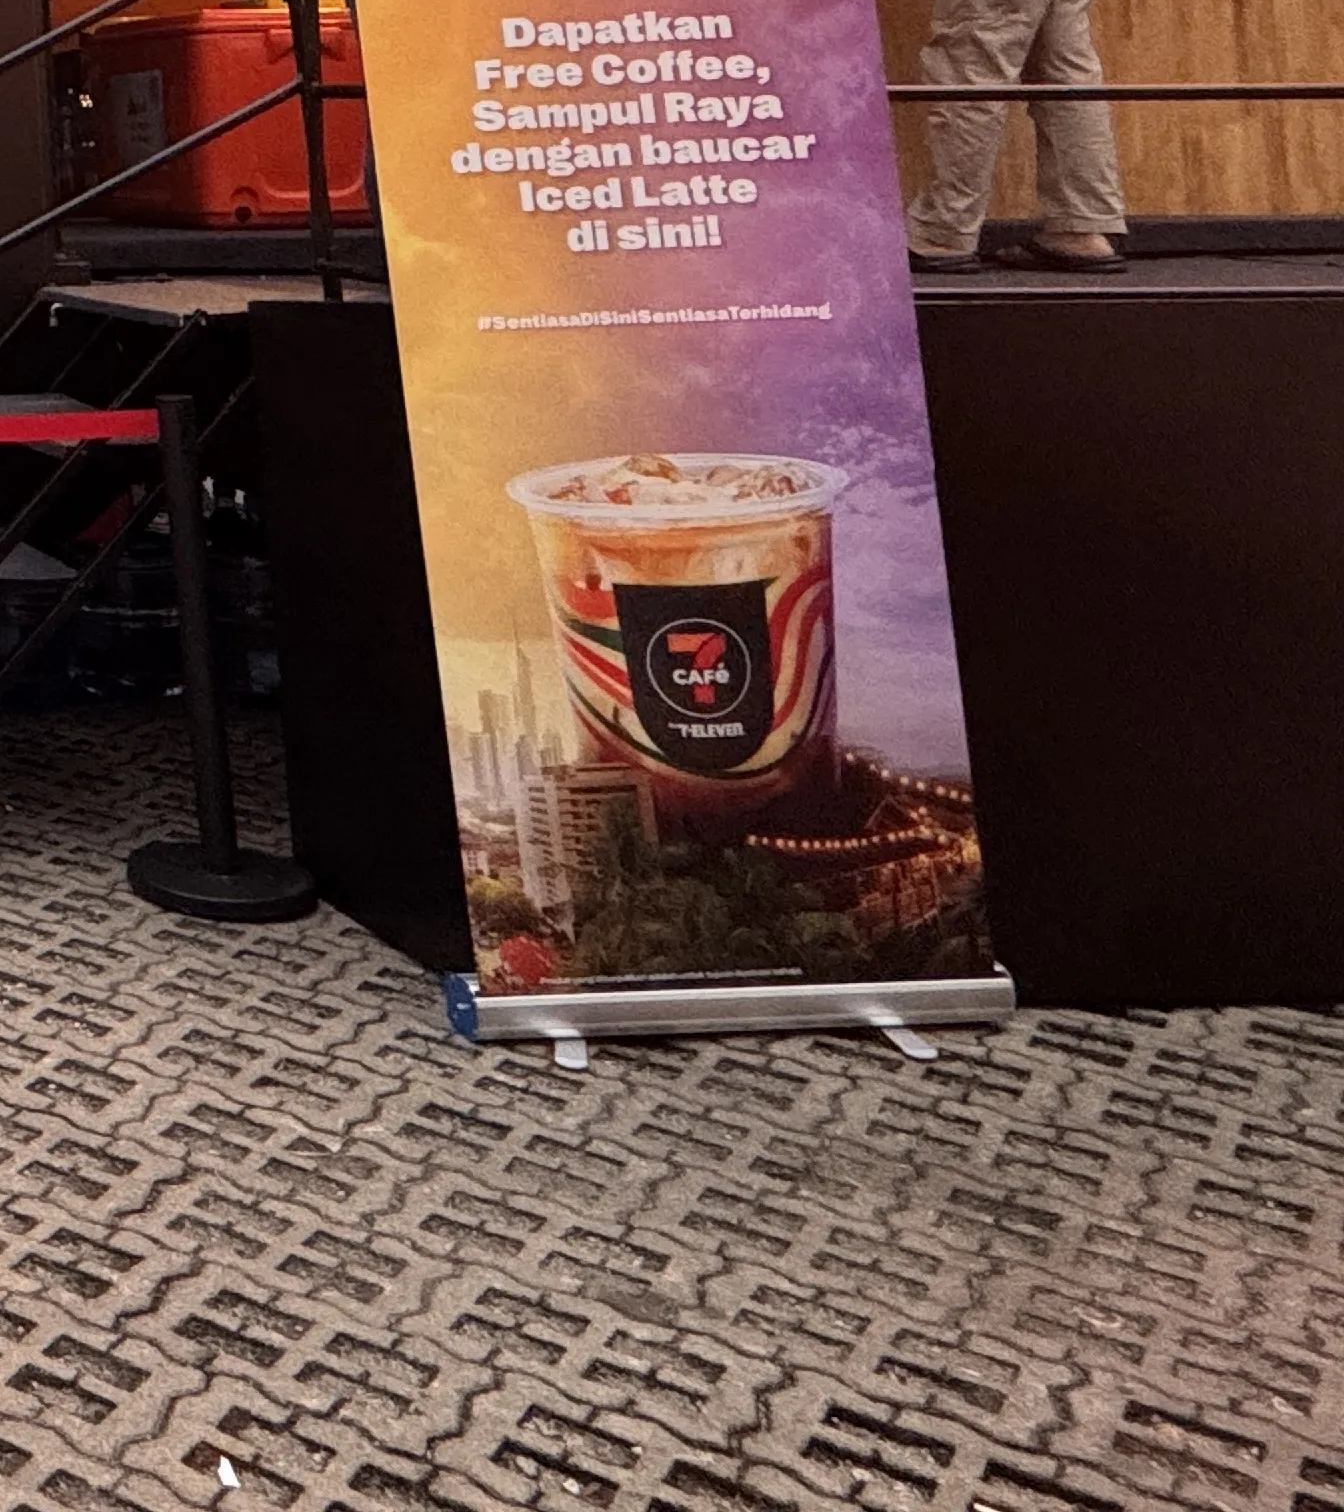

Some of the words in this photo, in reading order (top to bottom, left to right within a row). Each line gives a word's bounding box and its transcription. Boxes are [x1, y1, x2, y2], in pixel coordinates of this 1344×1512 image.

[501, 11, 734, 52] Dapatkan
[474, 59, 584, 90] Free
[591, 50, 771, 86] Coffee,
[472, 92, 657, 134] Sampul
[663, 91, 784, 128] Raya
[450, 137, 633, 178] dengan
[639, 133, 816, 166] baucar
[519, 177, 623, 212] Iced
[630, 174, 758, 208] Latte
[567, 220, 610, 252] di
[616, 215, 723, 250] sini!
[478, 301, 833, 332] #SentiasaDiSiniSentiasaTerhidang
[666, 632, 726, 704] 7
